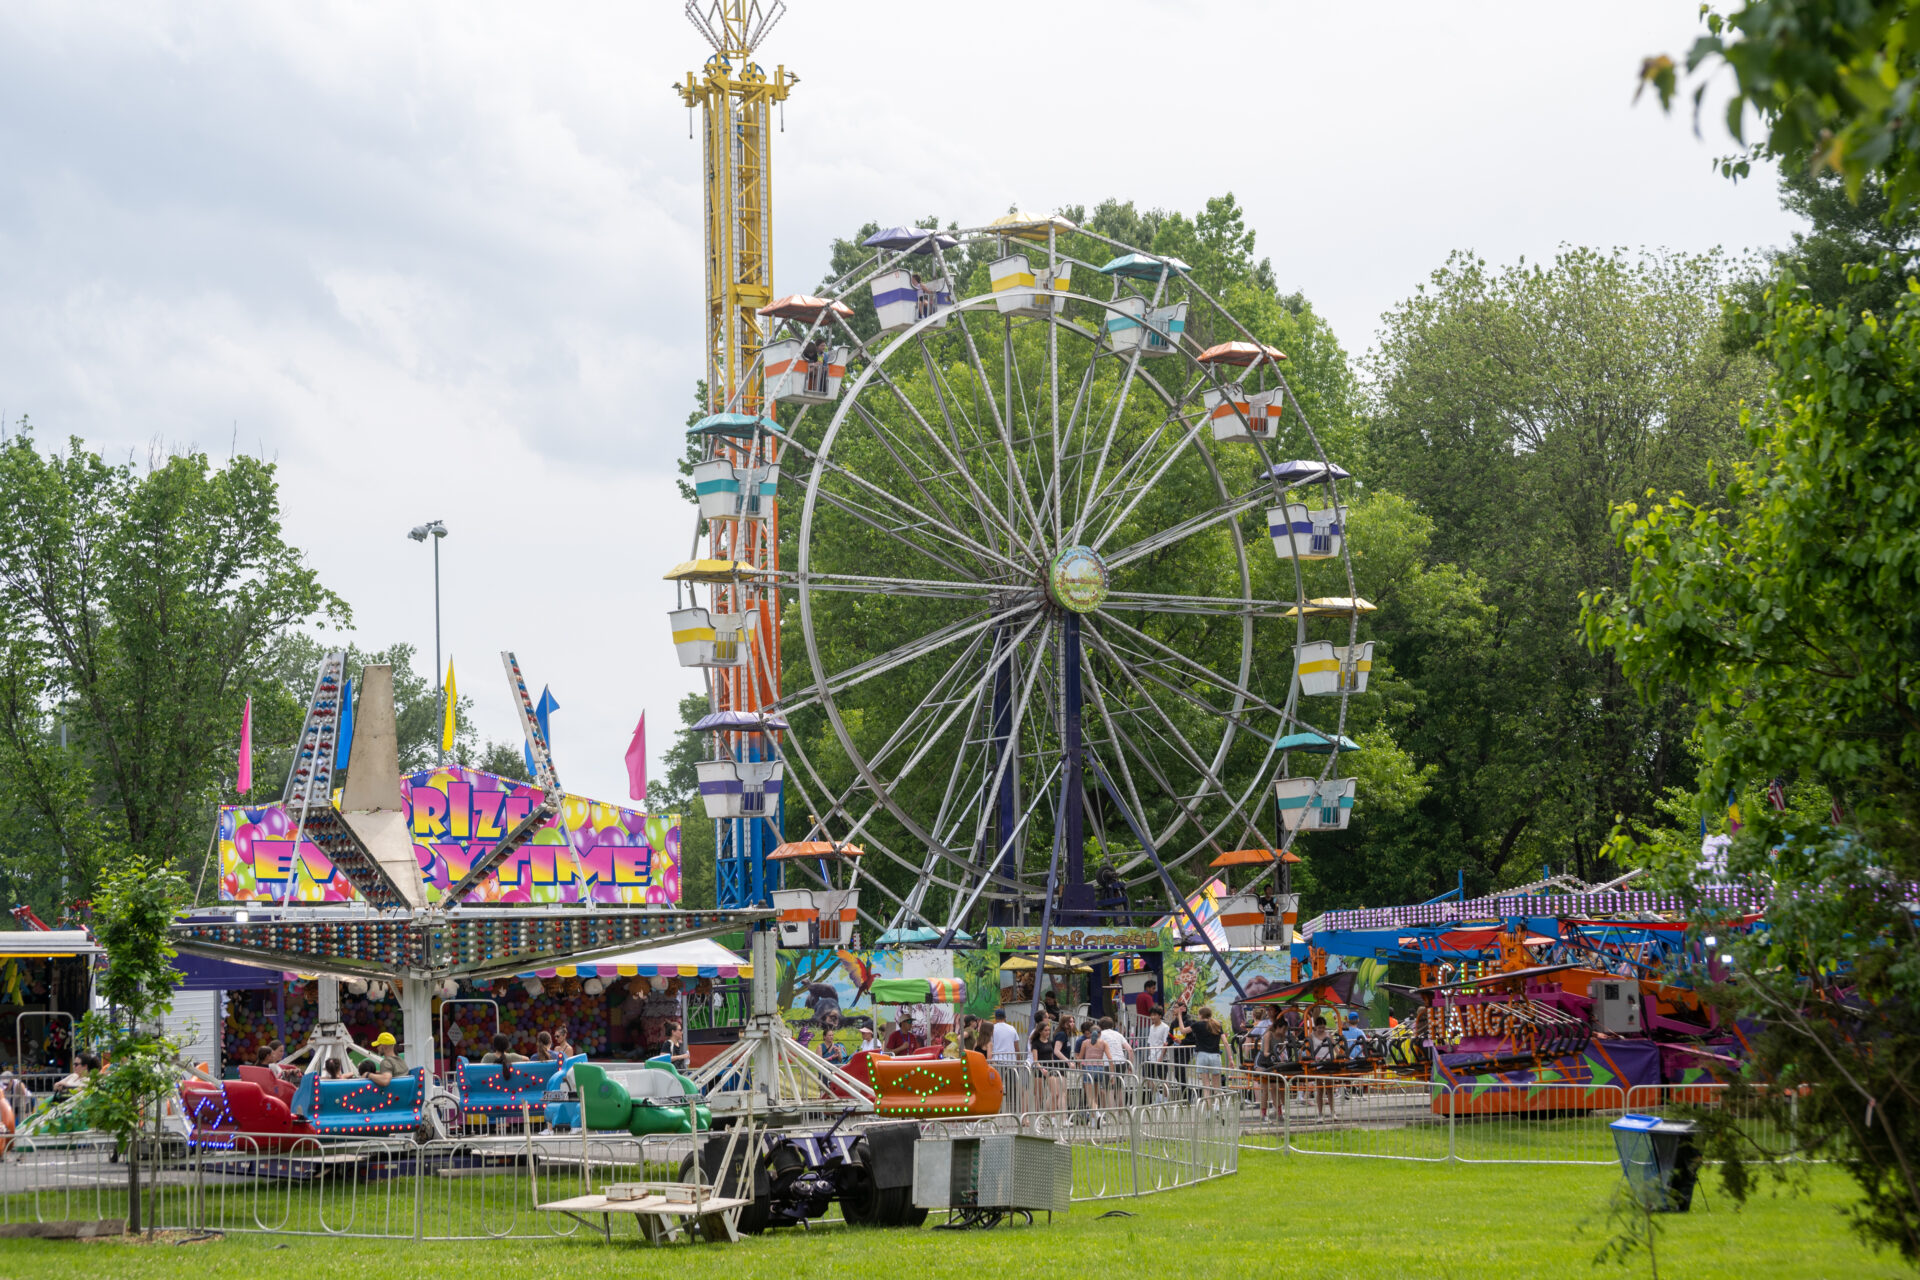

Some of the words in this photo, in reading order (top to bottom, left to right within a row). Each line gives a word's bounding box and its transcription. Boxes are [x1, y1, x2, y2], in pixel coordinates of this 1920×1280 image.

[401, 781, 533, 842] RIZE
[251, 839, 653, 886] EVYTIME
[1004, 930, 1160, 949] Rainforest
